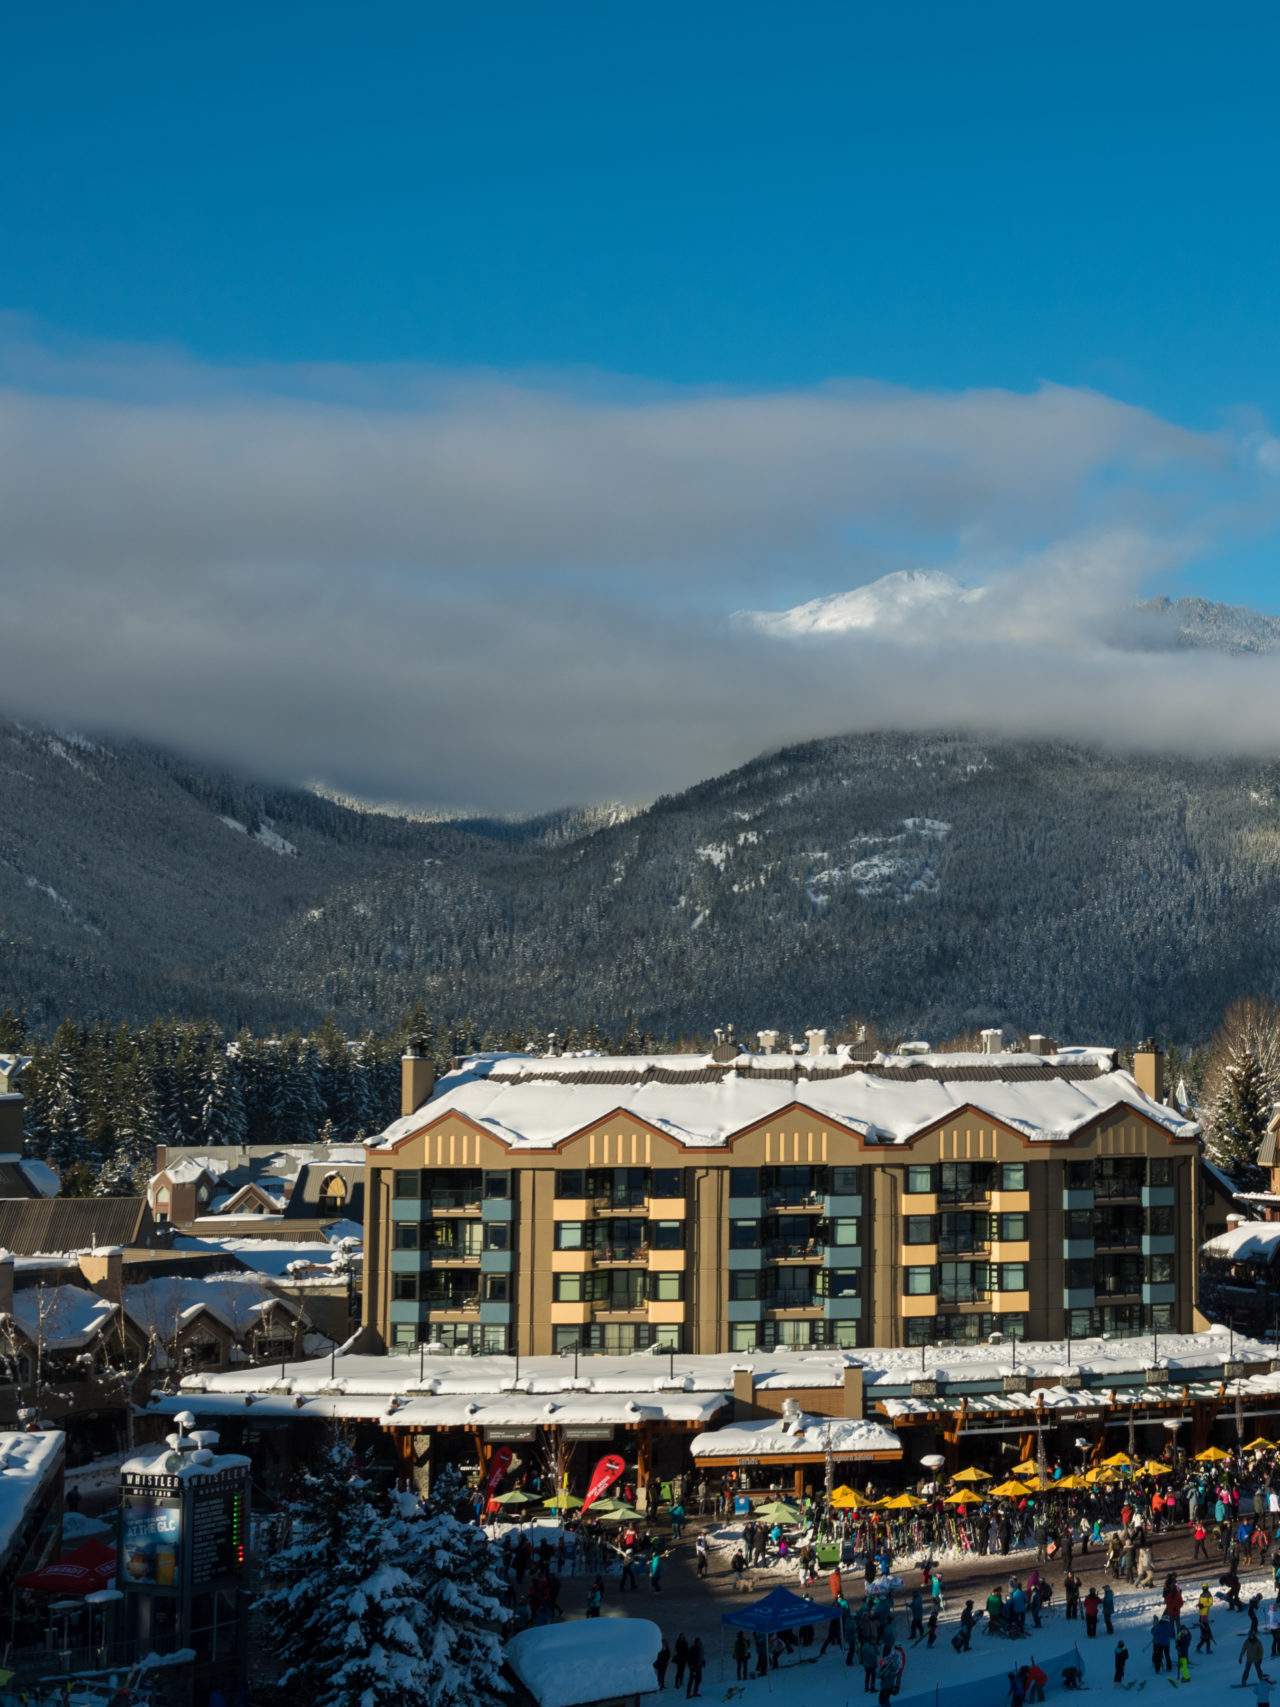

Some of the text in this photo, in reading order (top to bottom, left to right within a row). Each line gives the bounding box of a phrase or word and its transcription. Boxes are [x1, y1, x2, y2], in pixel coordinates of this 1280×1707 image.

[126, 1474, 179, 1488] WHISTLER
[191, 1467, 246, 1487] WHISTLER
[133, 1488, 172, 1497] MOUNTAIN
[127, 1526, 138, 1538] AT
[138, 1522, 156, 1535] THE
[156, 1519, 177, 1533] GLC
